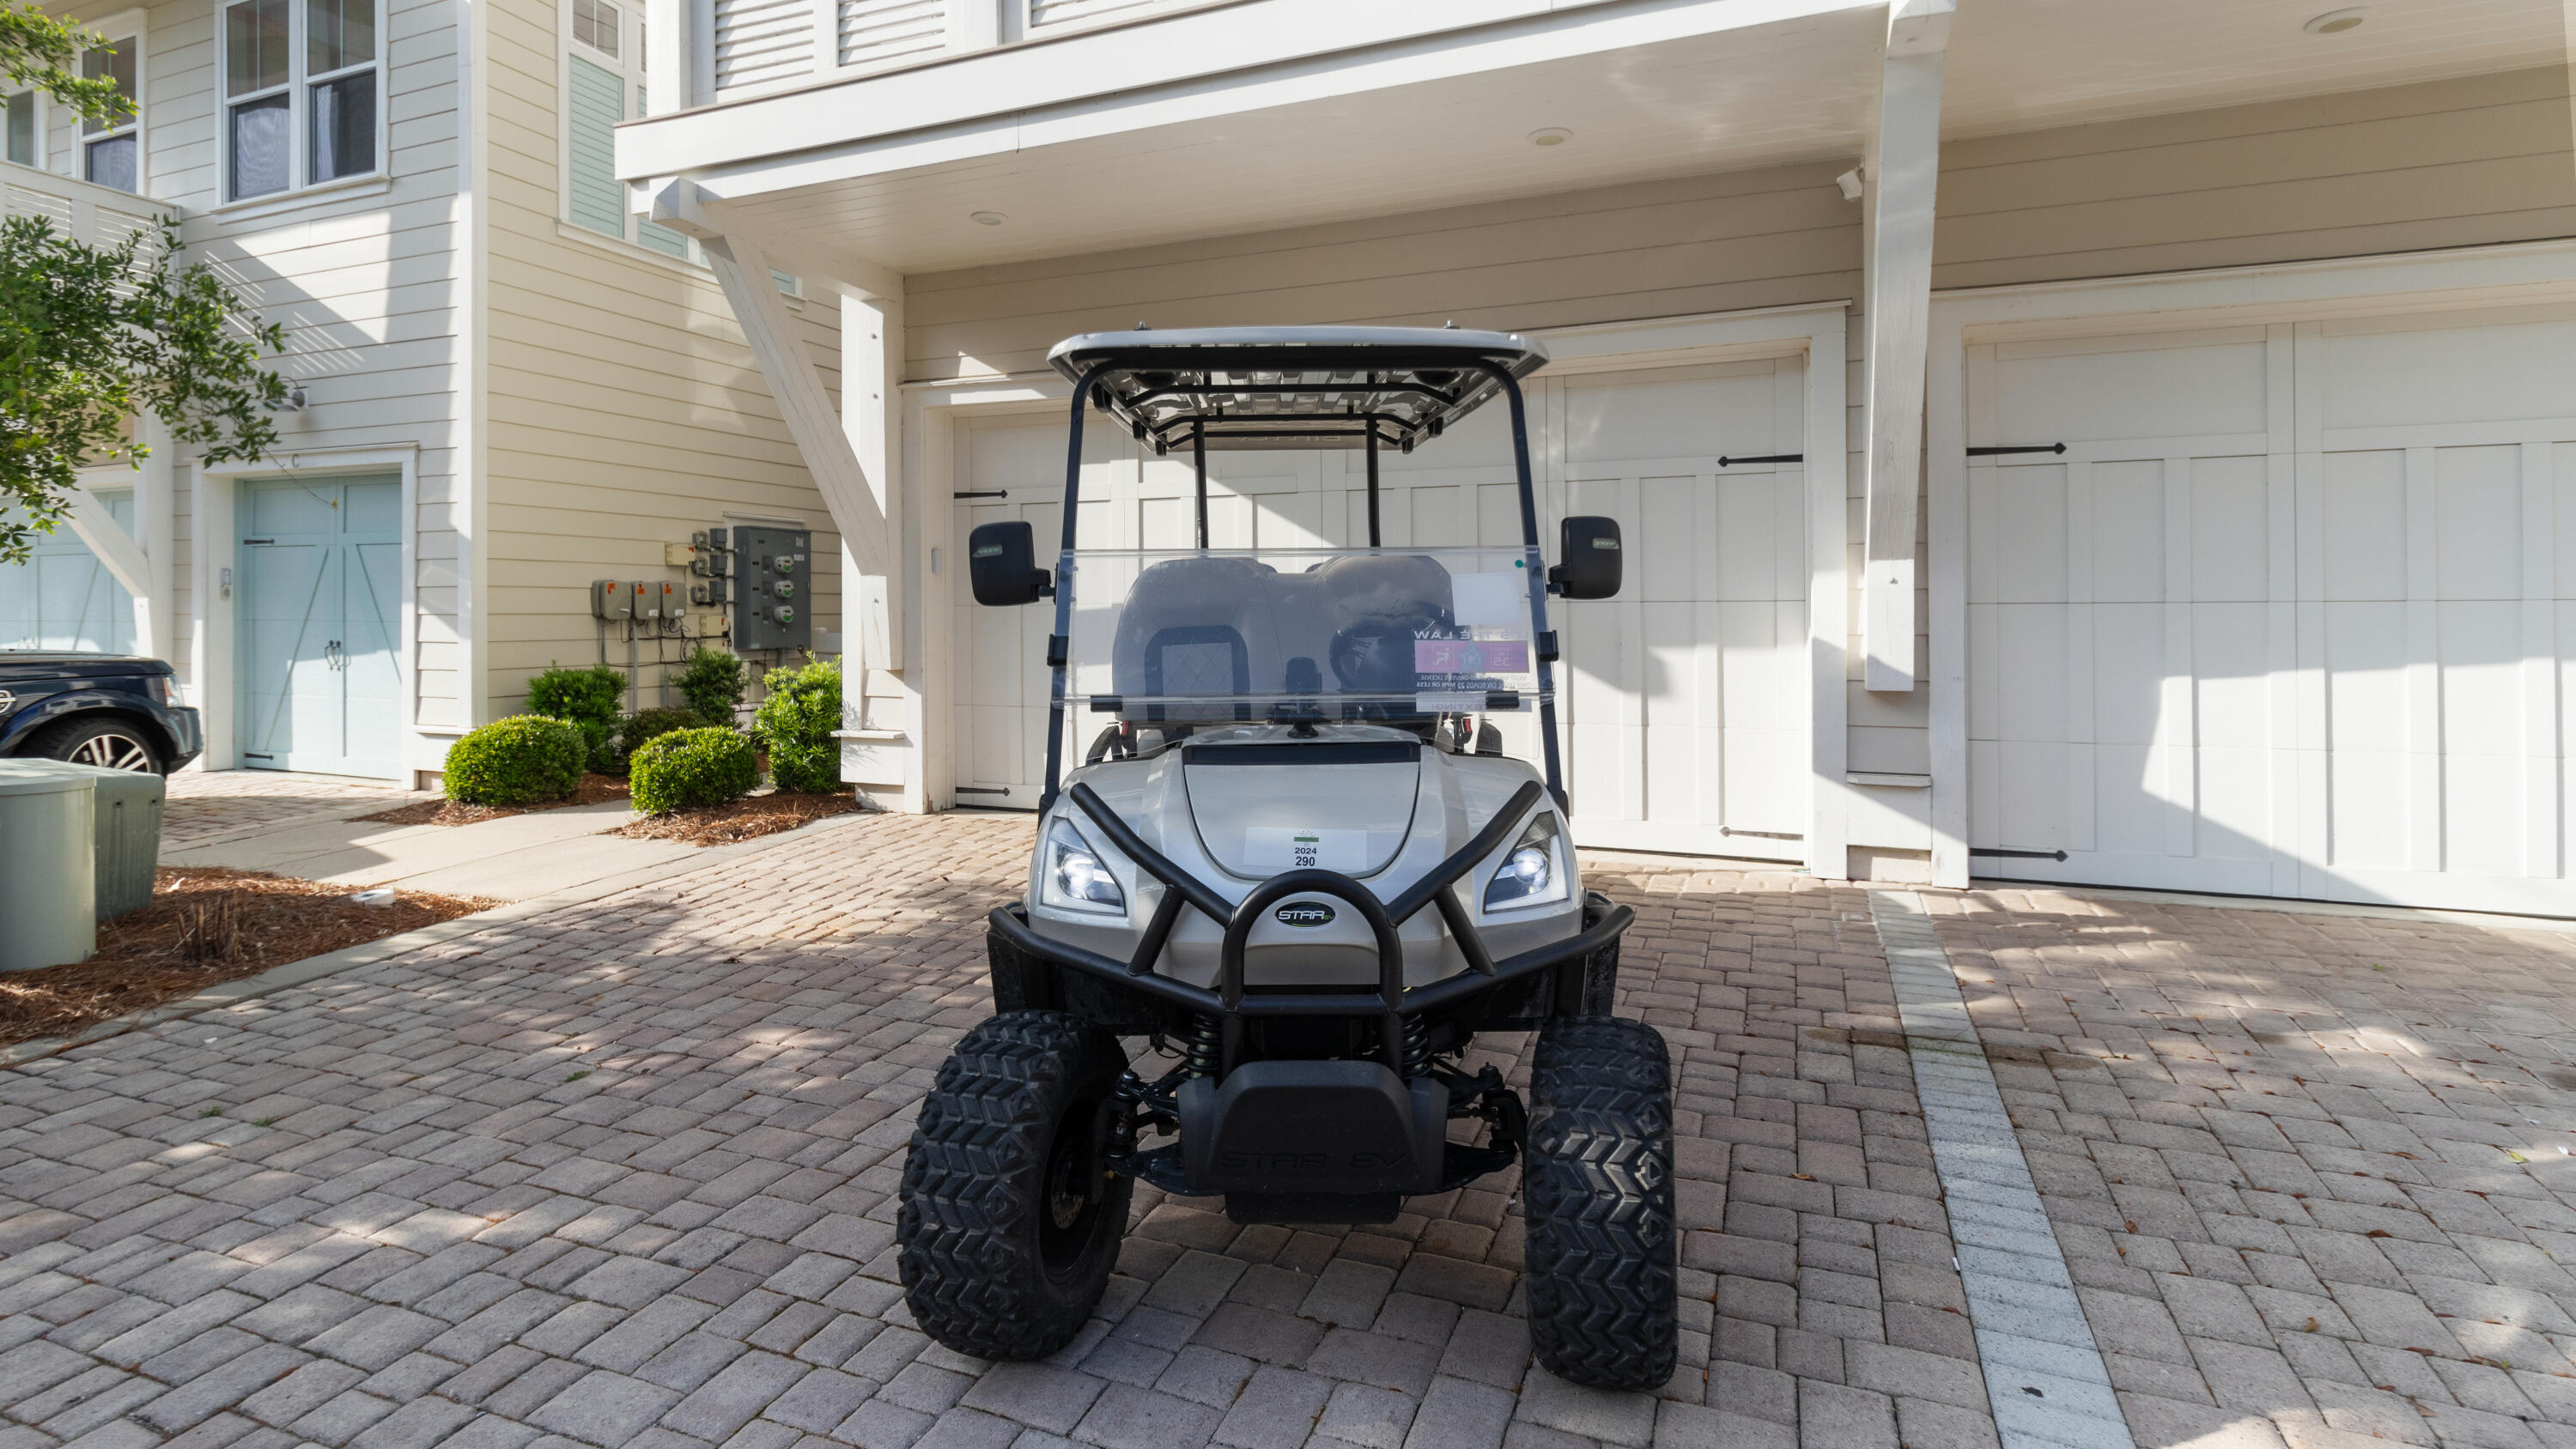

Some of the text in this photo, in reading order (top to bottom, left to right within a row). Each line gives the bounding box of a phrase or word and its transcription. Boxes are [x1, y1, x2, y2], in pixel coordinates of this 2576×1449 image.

[1294, 846, 1317, 855] 2024
[1295, 856, 1315, 867] 290
[1279, 911, 1325, 920] STAR
[1220, 1152, 1327, 1168] STAR
